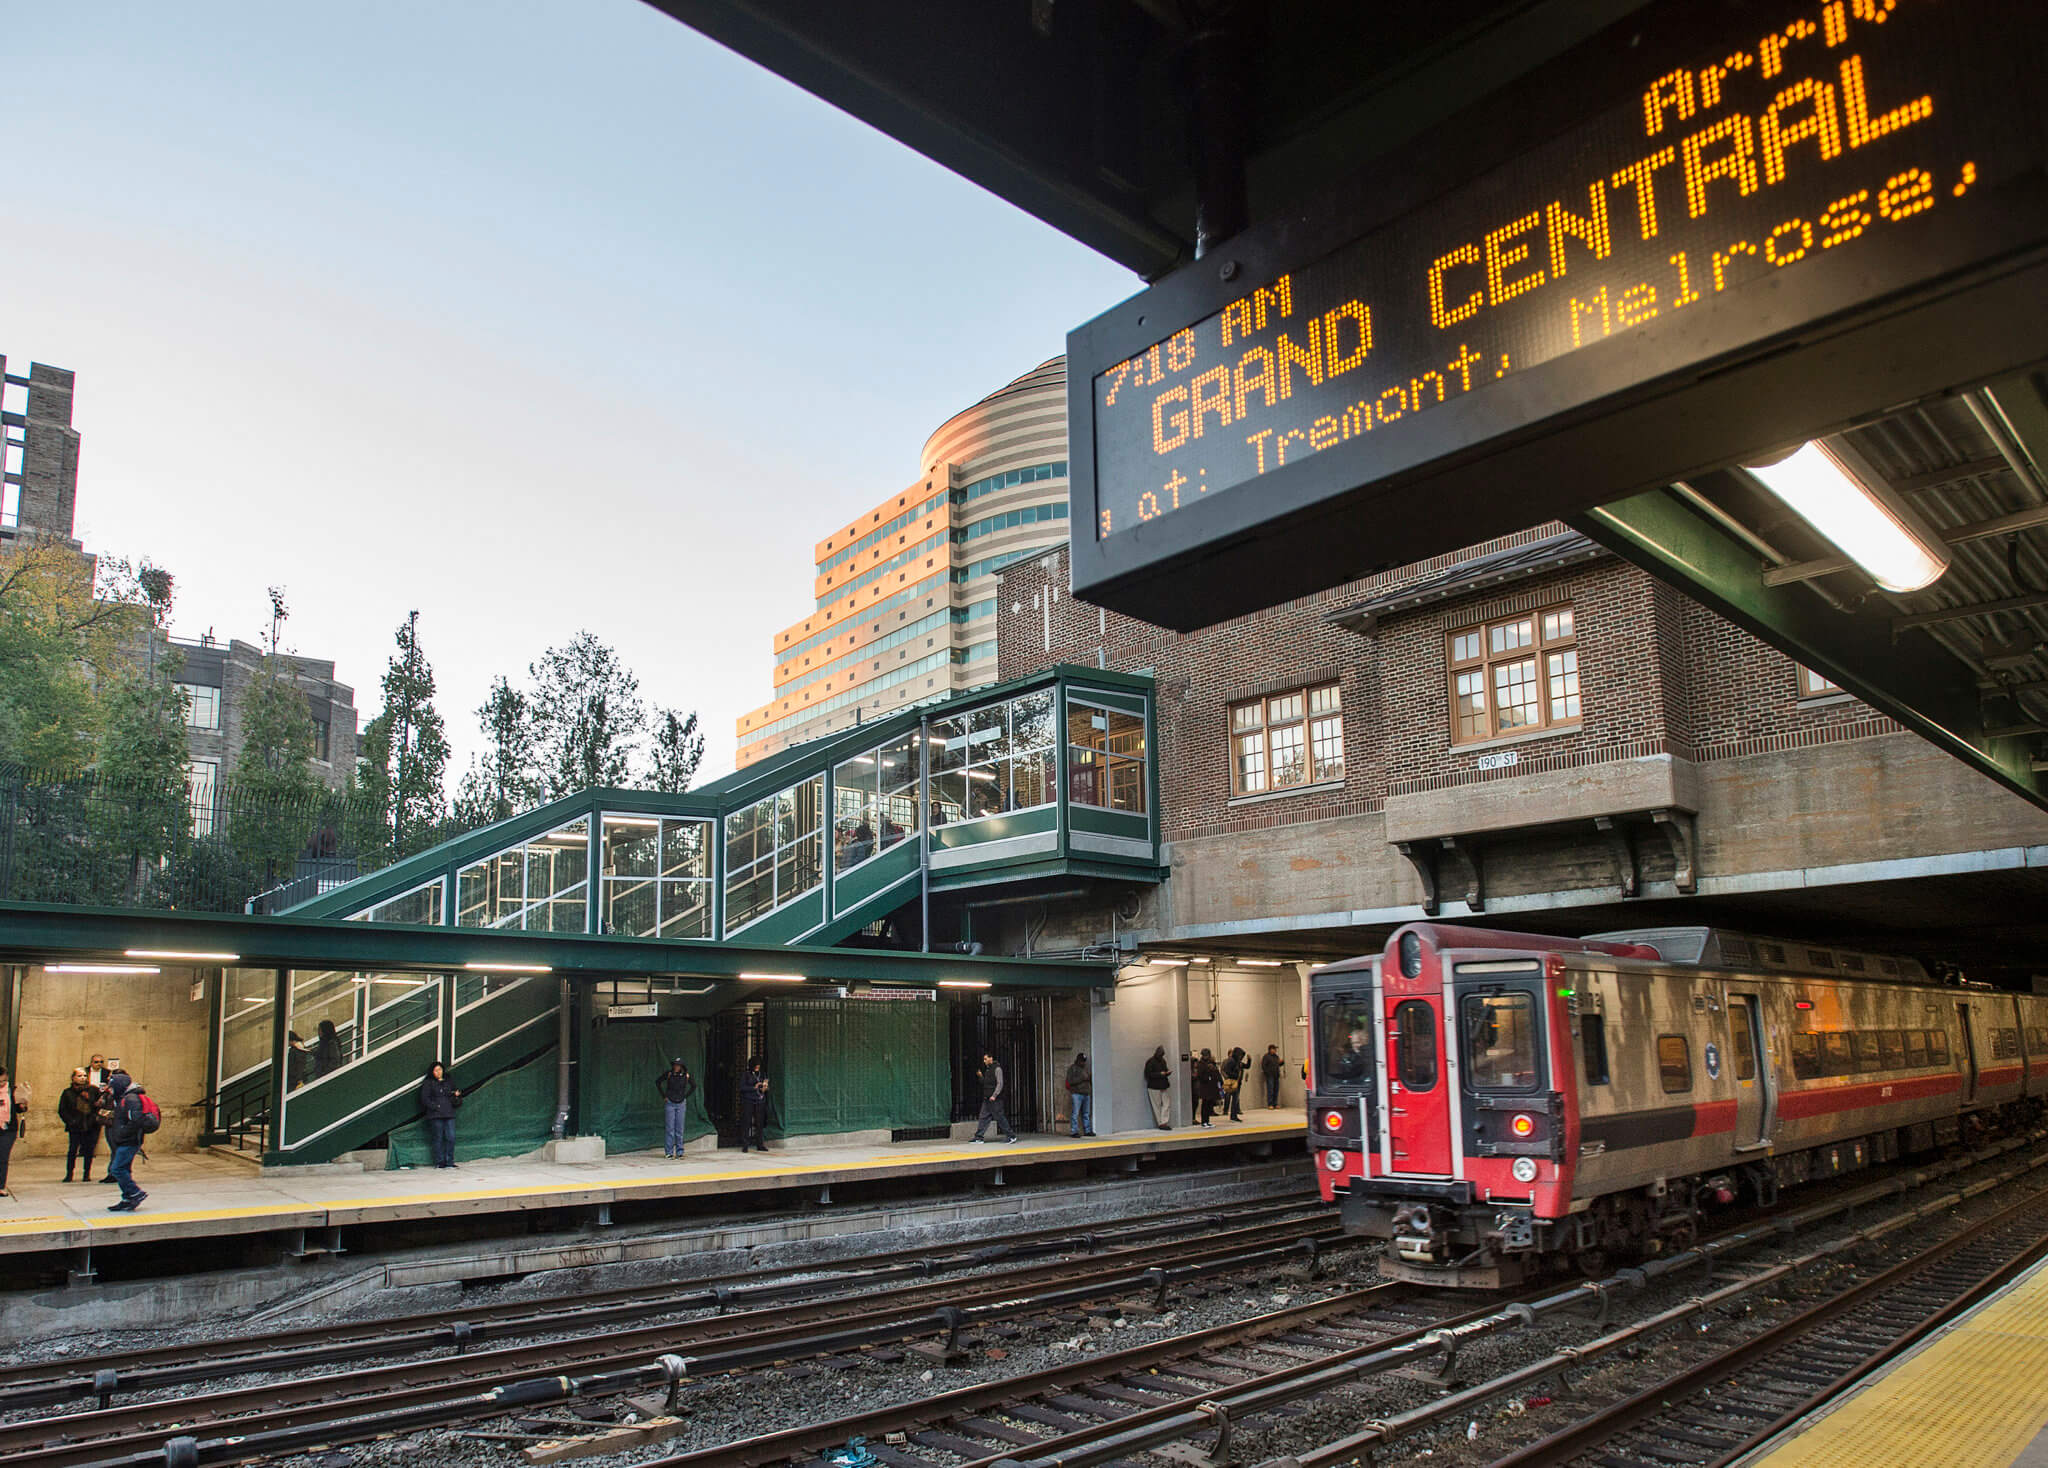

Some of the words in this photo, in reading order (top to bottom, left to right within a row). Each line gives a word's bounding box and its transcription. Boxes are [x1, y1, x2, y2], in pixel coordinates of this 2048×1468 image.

[1104, 328, 1196, 407] 7:18
[1220, 274, 1292, 348] AM
[1138, 468, 1207, 521] at:
[1246, 344, 1510, 475] Tremont,
[1569, 161, 1977, 349] Melrose,
[1151, 299, 1373, 455] GRAND
[1427, 54, 1934, 329] CENTRAL
[1503, 752, 1517, 766] ST
